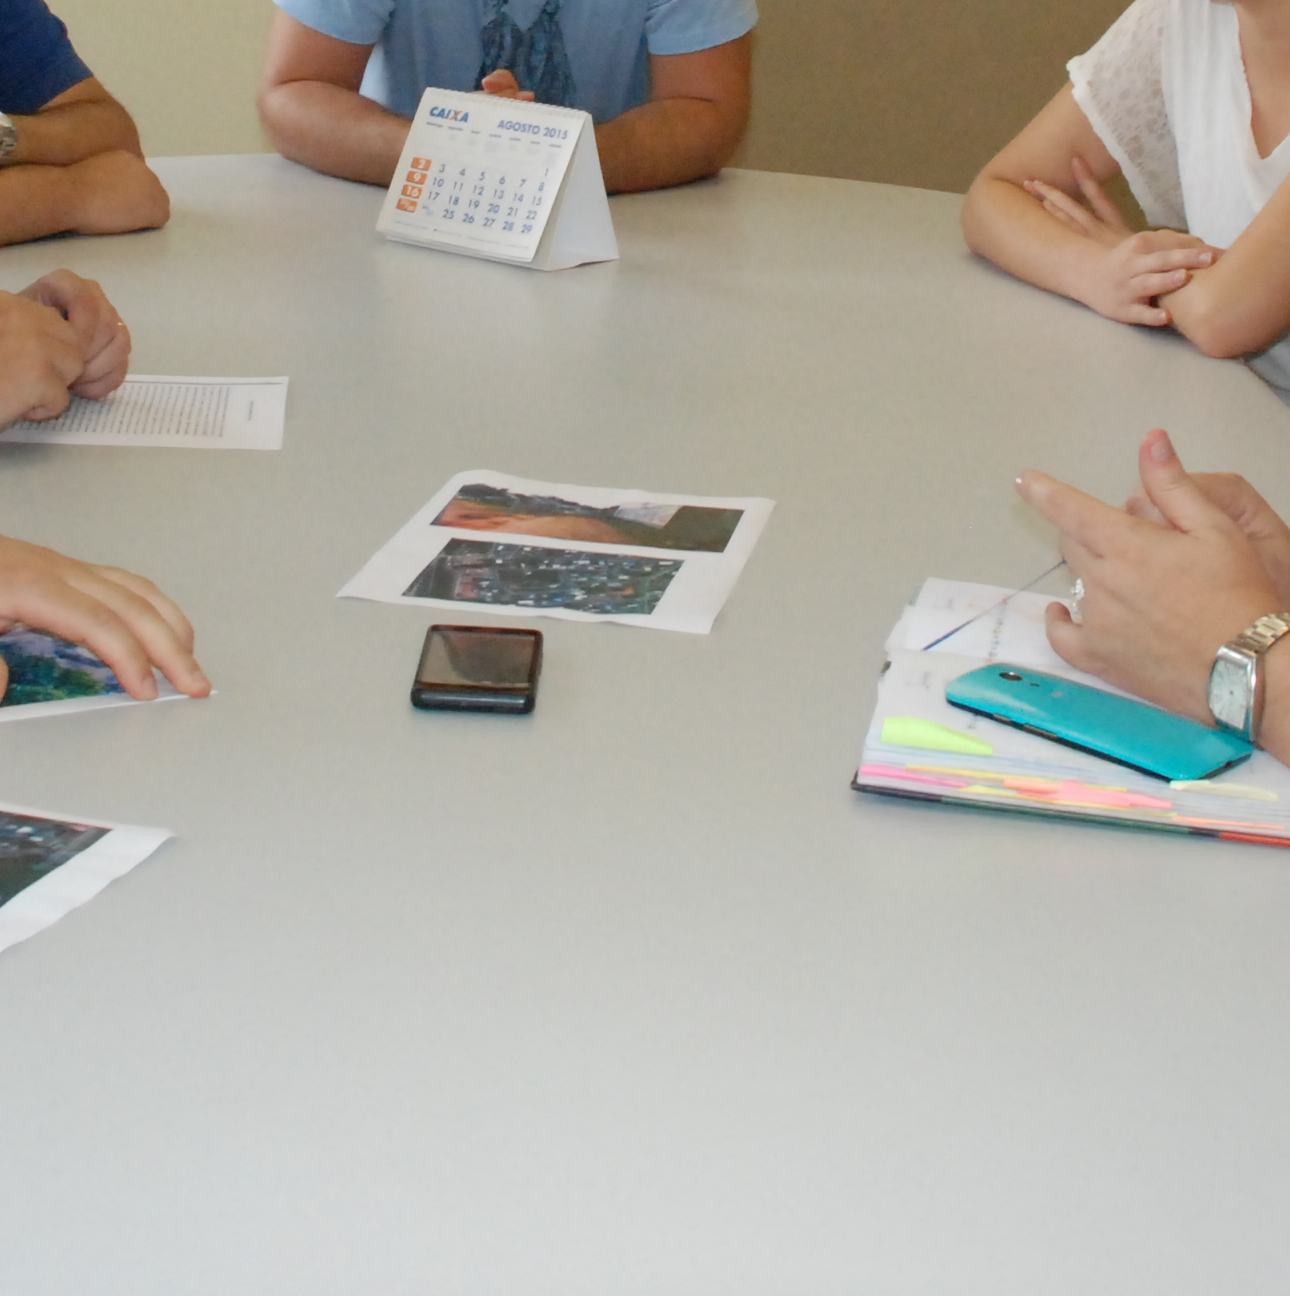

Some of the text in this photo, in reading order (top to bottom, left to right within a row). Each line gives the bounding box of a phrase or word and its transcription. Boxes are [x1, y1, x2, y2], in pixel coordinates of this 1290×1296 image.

[429, 106, 470, 123] CAIXA
[497, 120, 569, 140] AGOSTO 2015
[413, 172, 543, 206] 9 10 11 12 13 14 15
[417, 157, 545, 191] 2 3 4 5 6 7 8
[406, 185, 538, 220] 16 17 18 19 20 21 22
[442, 208, 455, 219] 25
[462, 213, 475, 224] 26
[482, 217, 496, 227] 27
[501, 221, 515, 232] 28
[520, 224, 533, 234] 29
